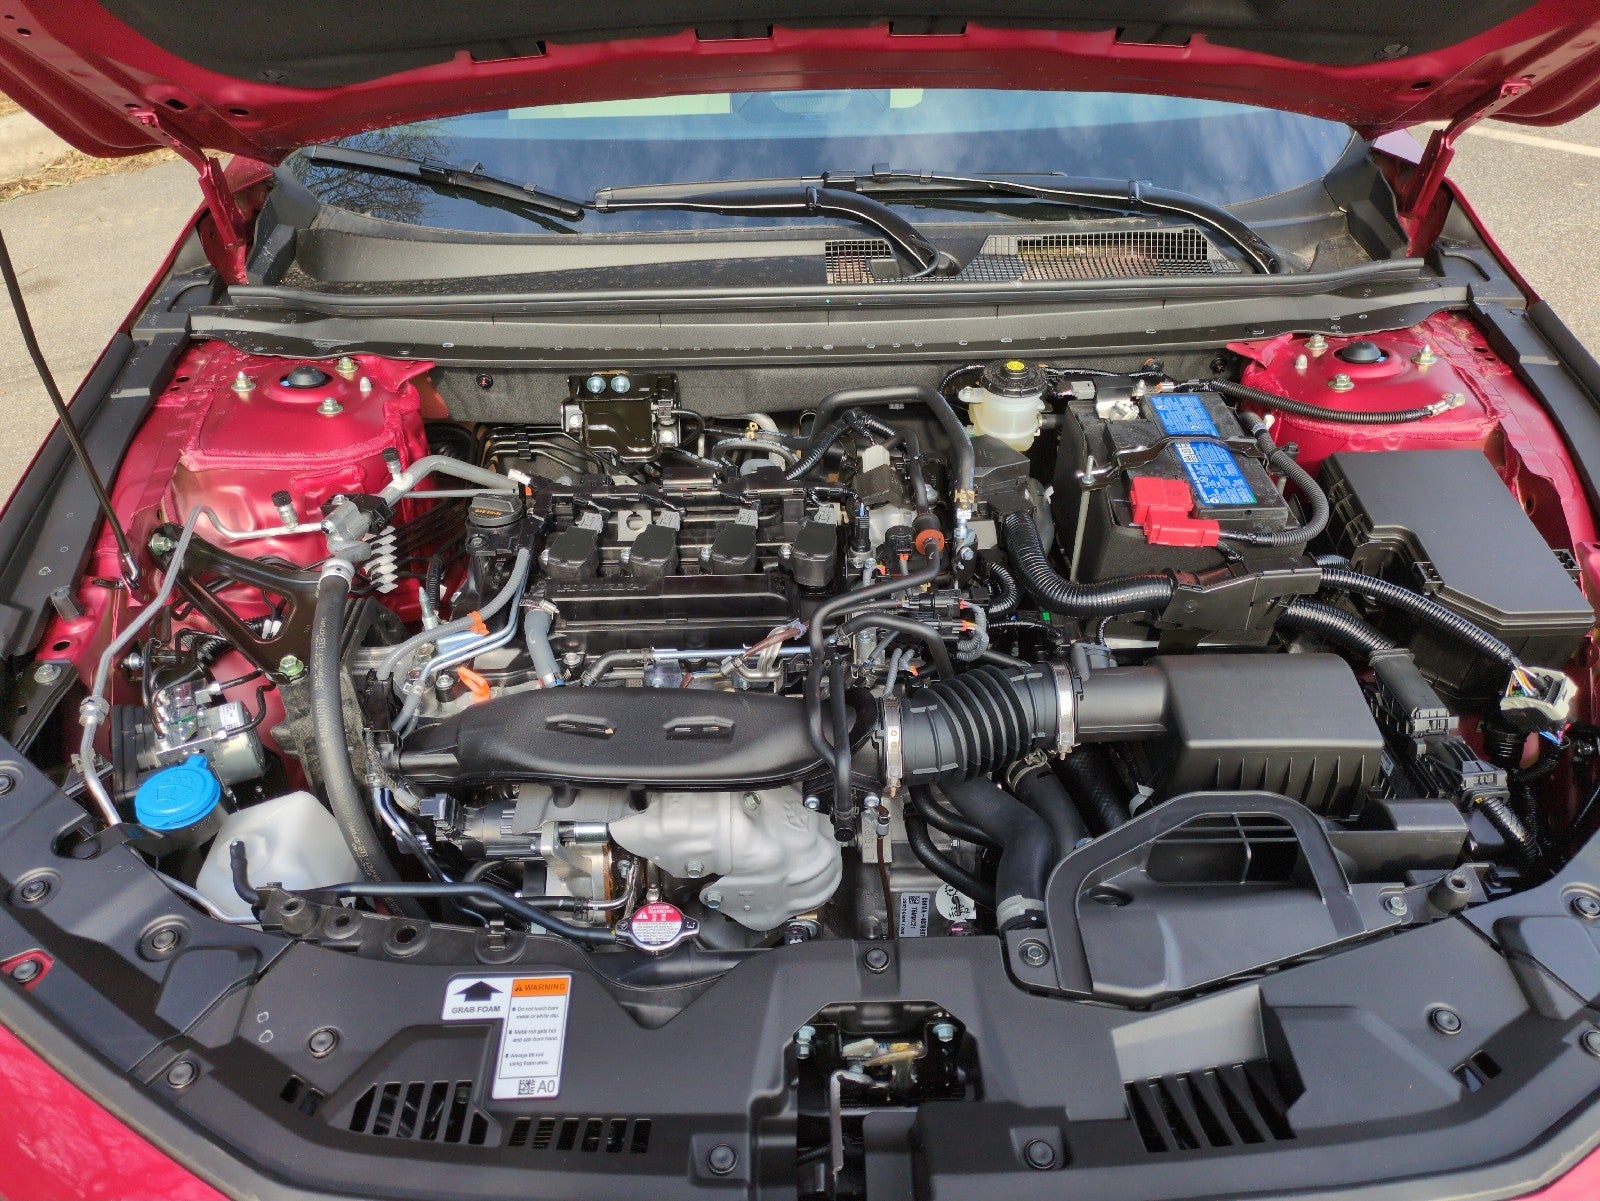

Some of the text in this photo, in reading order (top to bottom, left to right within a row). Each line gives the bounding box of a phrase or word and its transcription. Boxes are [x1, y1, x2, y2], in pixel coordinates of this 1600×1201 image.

[524, 983, 566, 992] WARNING
[451, 1005, 501, 1014] GRAB FOAM
[537, 1079, 556, 1093] A0
